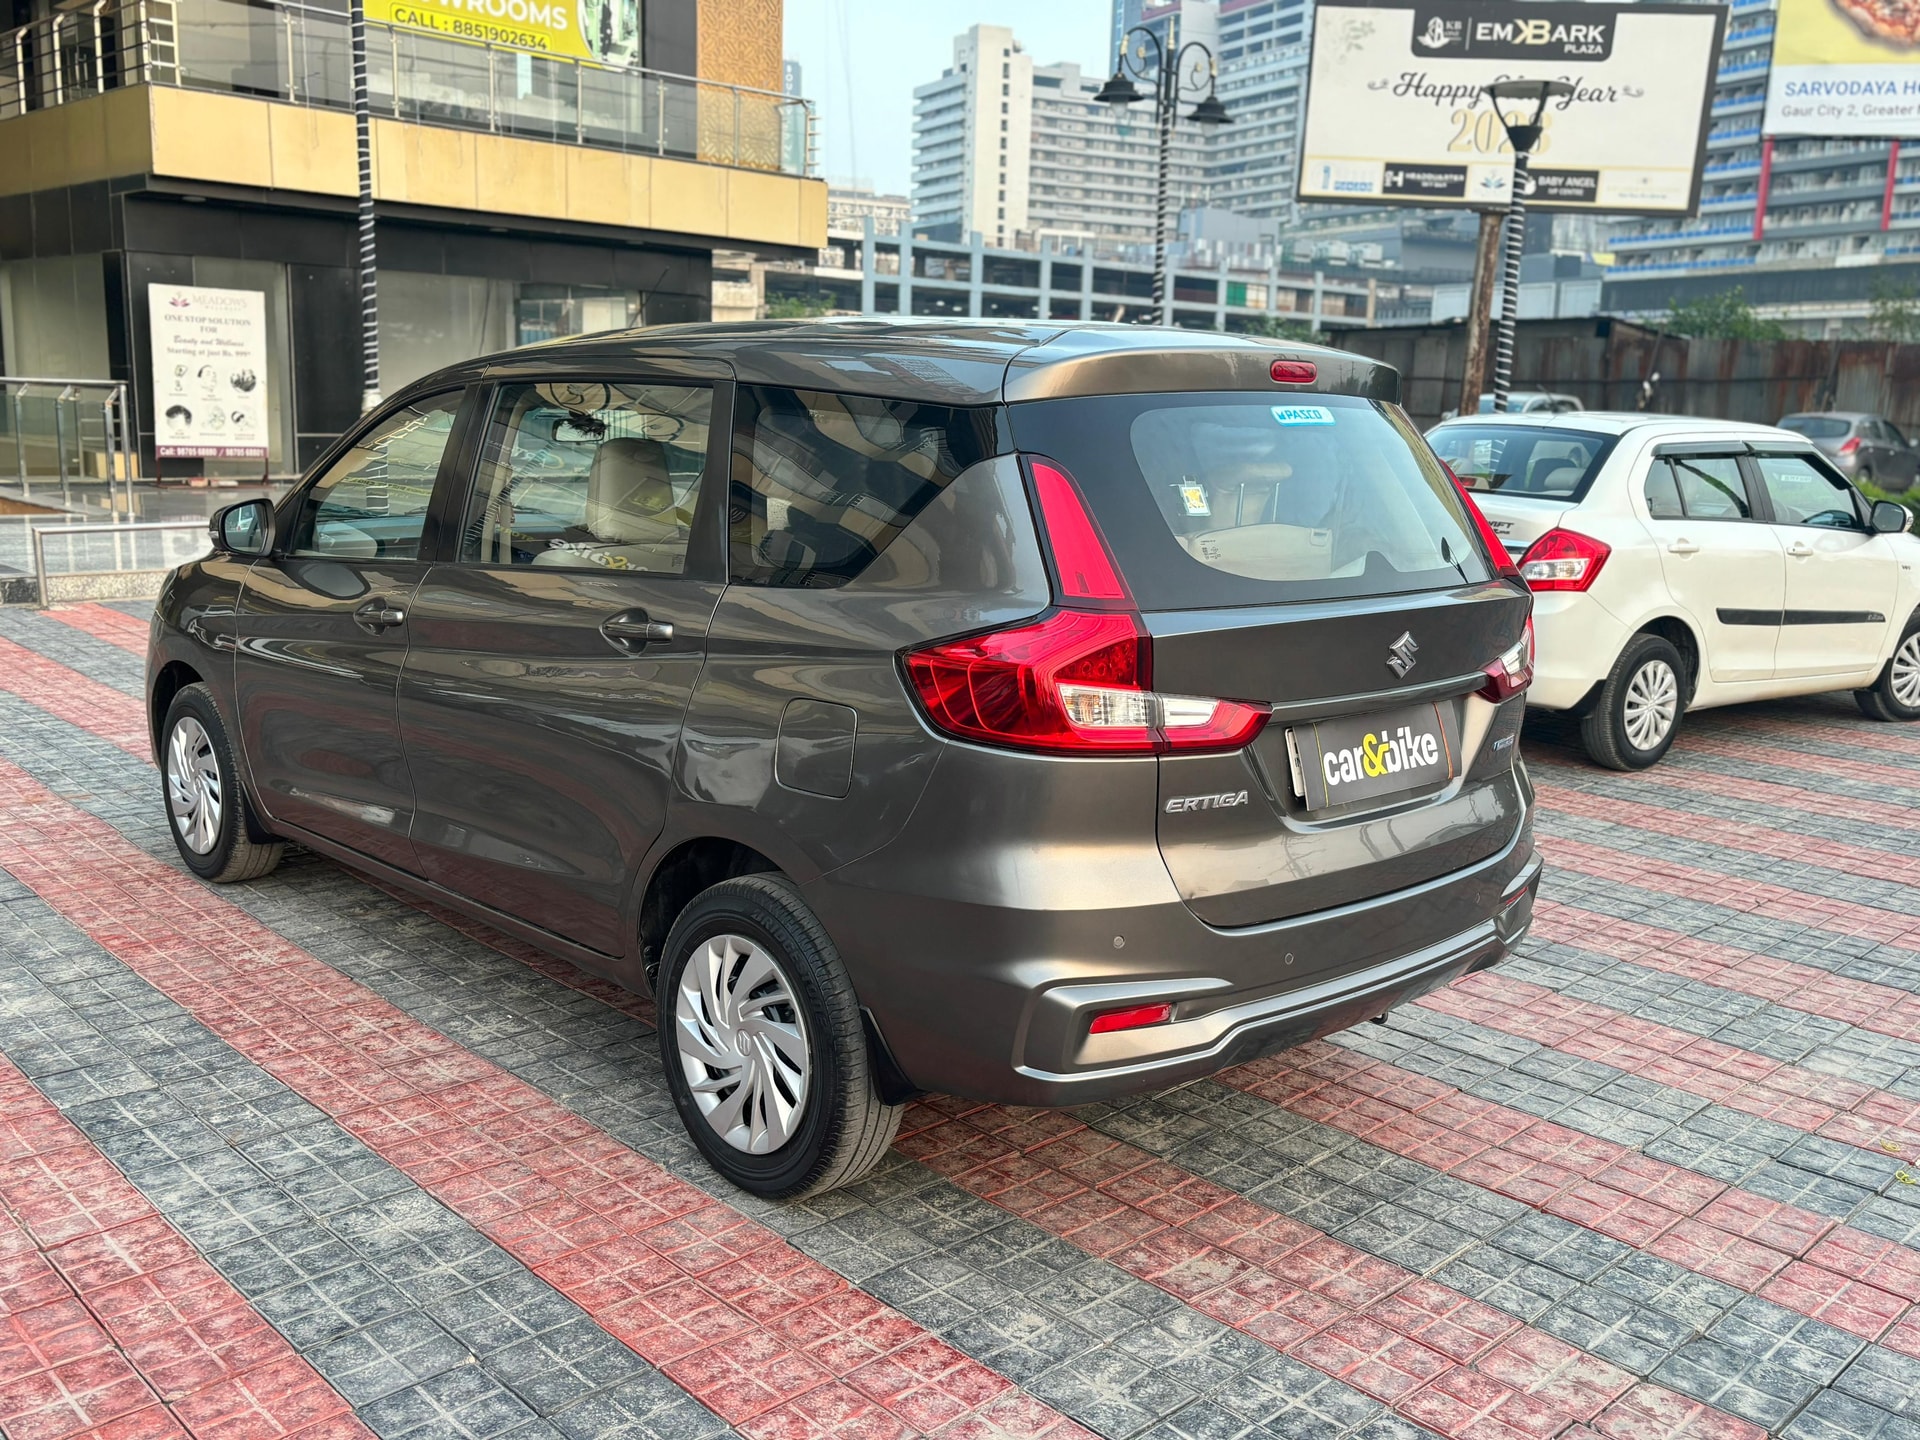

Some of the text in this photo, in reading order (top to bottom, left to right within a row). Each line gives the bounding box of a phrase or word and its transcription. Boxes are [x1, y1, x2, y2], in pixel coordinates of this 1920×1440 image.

[423, 0, 568, 30] ROOMS
[395, 8, 439, 29] CALL
[453, 20, 547, 50] 8851902634
[1563, 43, 1603, 54] PLAZA
[1393, 72, 1483, 110] Happy
[1784, 80, 1920, 97] SARVODAYA H
[1782, 105, 1814, 117] Gaur
[1817, 104, 1843, 119] City
[1863, 103, 1914, 116] Greater
[1538, 175, 1596, 188] BABY ANGEL
[164, 314, 251, 326] ONE STOP SOLUTION
[200, 325, 218, 333] FOR
[167, 347, 196, 357] Starting
[1323, 726, 1439, 786] car&bike
[1165, 790, 1248, 814] ERTIGA
